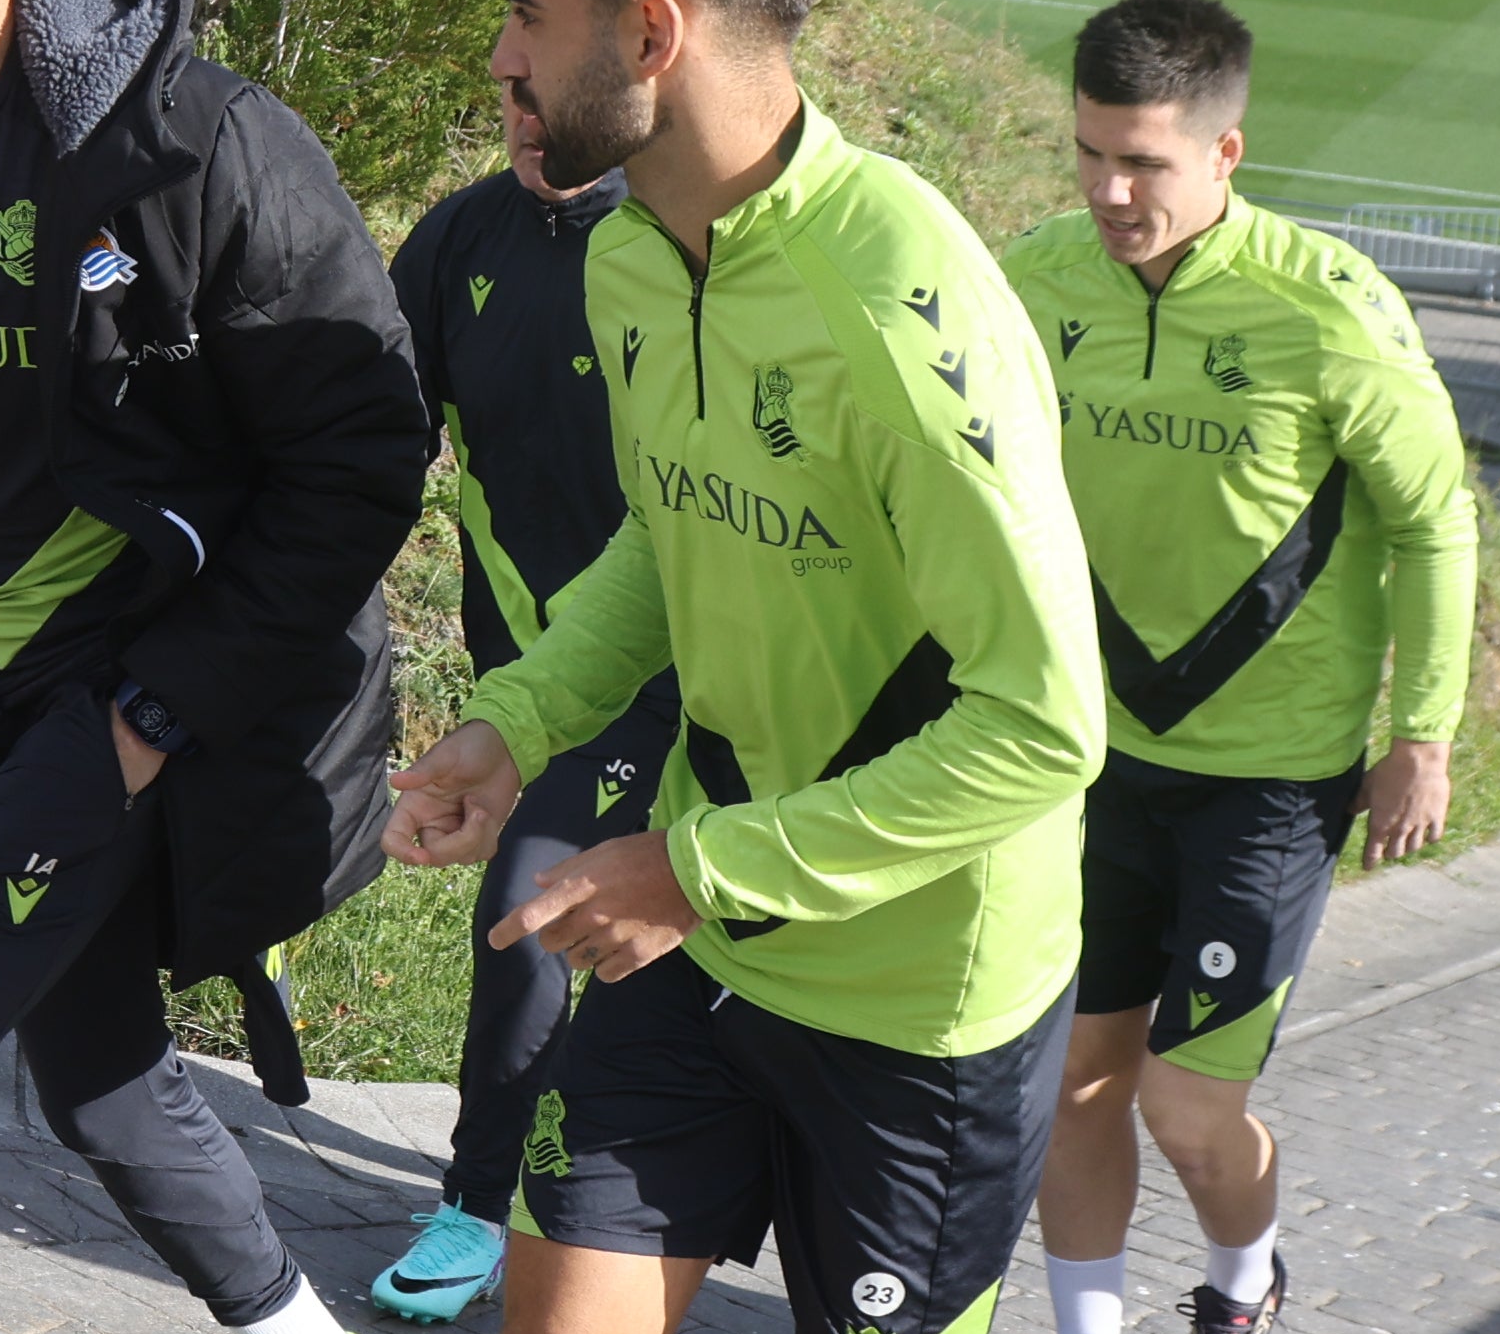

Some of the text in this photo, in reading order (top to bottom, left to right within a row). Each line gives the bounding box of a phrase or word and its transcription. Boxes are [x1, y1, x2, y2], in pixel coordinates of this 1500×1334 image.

[1084, 402, 1261, 456] YASUDA
[647, 454, 847, 551] YASUDA
[791, 555, 853, 577] group
[606, 758, 636, 781] JC
[23, 852, 59, 875] IA
[1211, 951, 1224, 967] 5
[861, 1283, 895, 1305] 23
